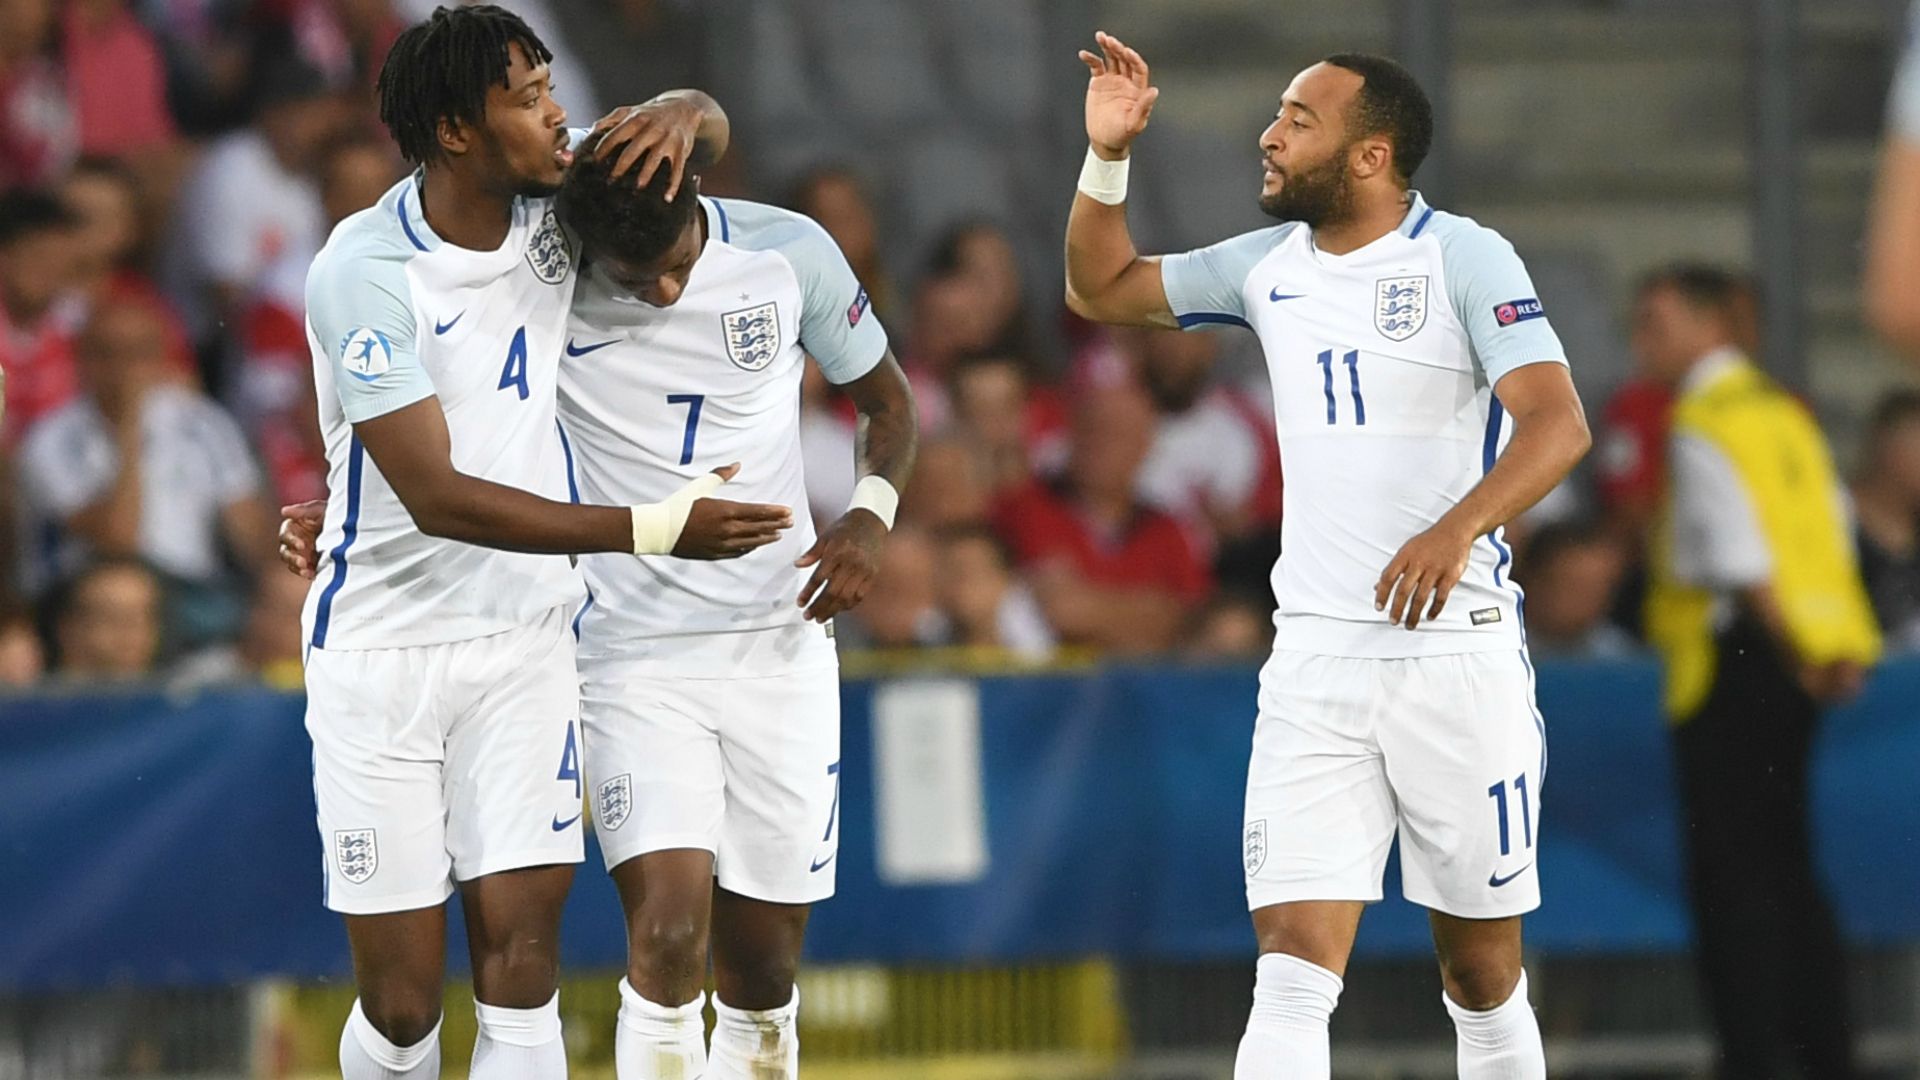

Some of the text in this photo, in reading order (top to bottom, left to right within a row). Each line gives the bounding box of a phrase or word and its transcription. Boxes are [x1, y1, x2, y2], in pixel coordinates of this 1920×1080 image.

[1516, 302, 1543, 315] RES
[496, 325, 530, 401] 4
[1316, 348, 1366, 426] 11
[666, 393, 705, 466] 7
[556, 719, 581, 800] 4
[822, 761, 840, 842] 7
[1487, 771, 1532, 857] 11
